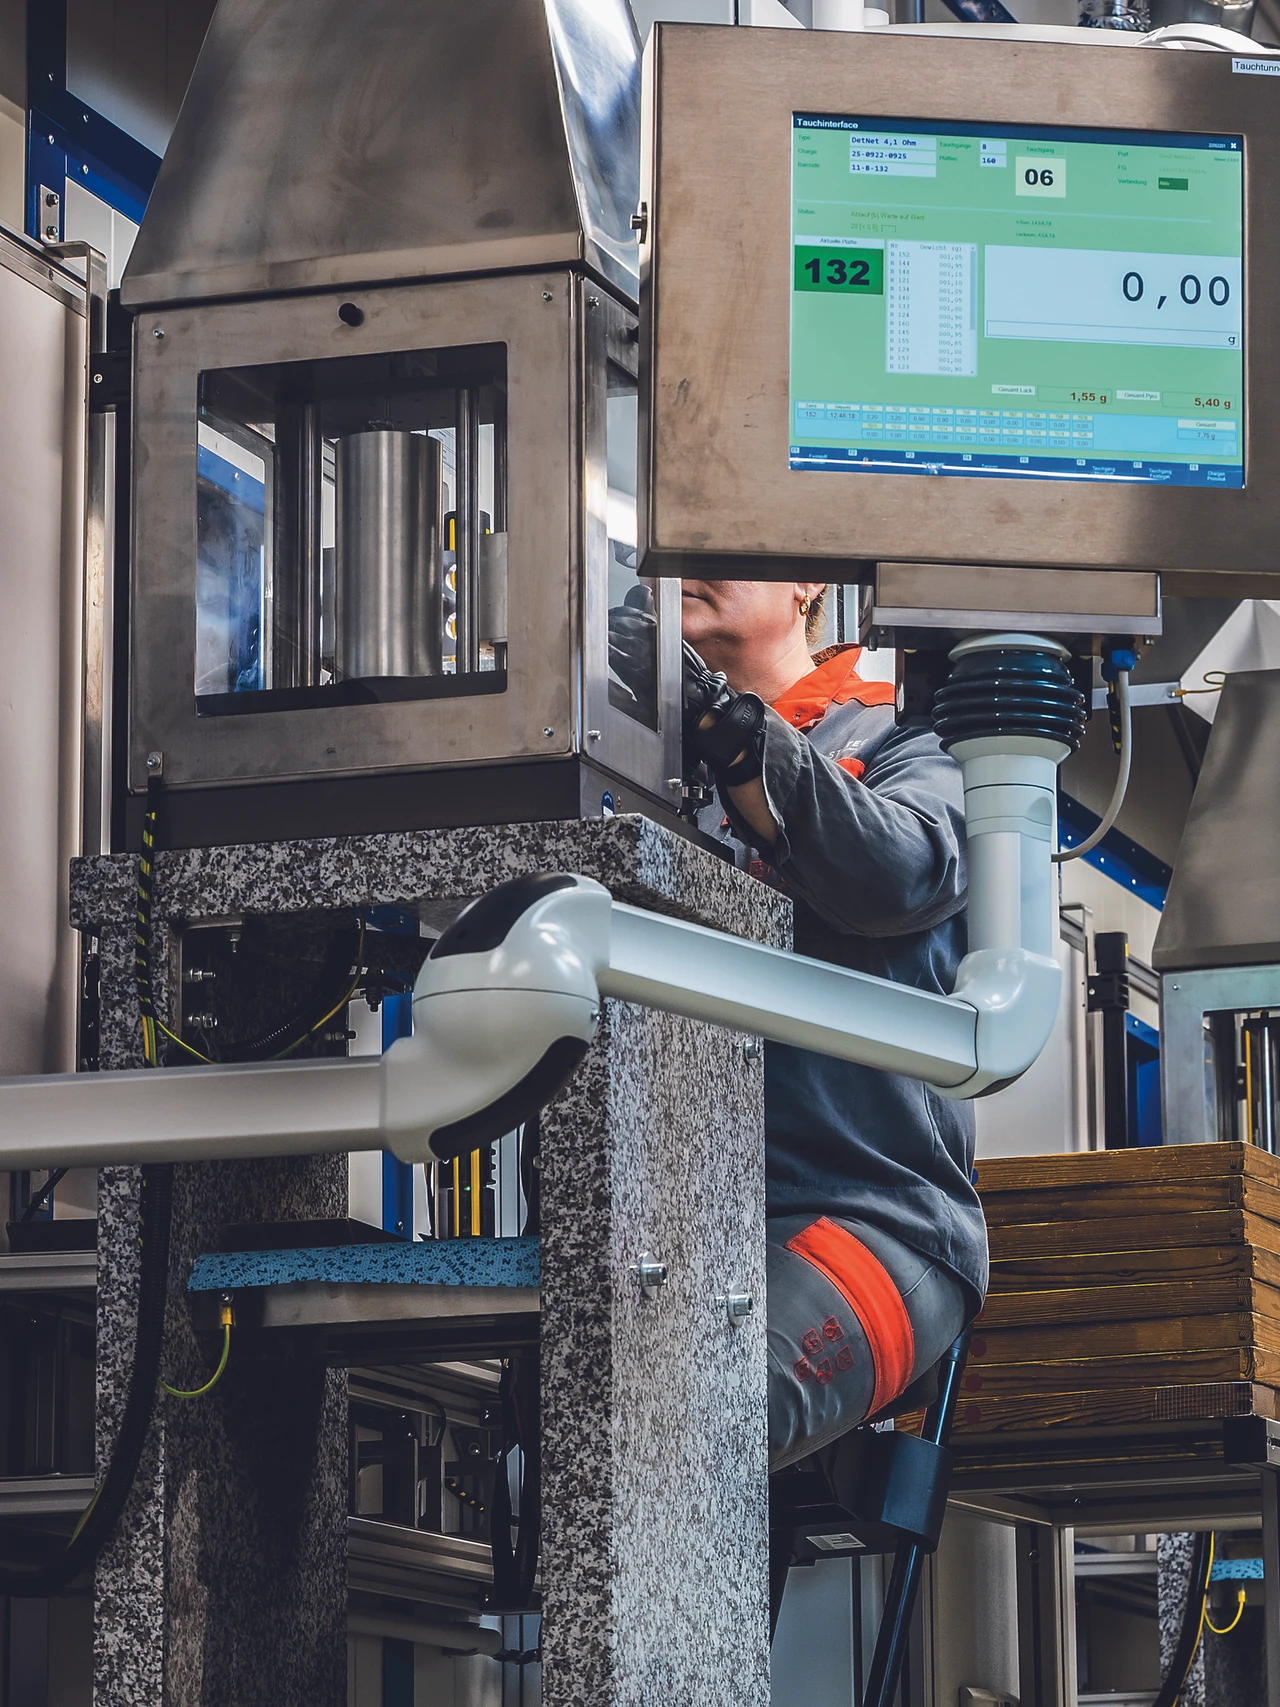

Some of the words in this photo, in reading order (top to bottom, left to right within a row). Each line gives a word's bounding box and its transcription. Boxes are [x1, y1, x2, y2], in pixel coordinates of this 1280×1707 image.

[796, 118, 858, 129] Tauchinterface
[852, 151, 907, 160] 25-0922-0925
[1024, 168, 1054, 186] 06
[804, 258, 870, 286] 132
[1122, 271, 1230, 310] 0,00
[1228, 335, 1236, 345] g
[1070, 392, 1096, 403] 1,55
[1100, 394, 1107, 404] g
[1194, 397, 1220, 408] 5,40
[1224, 400, 1231, 410] g
